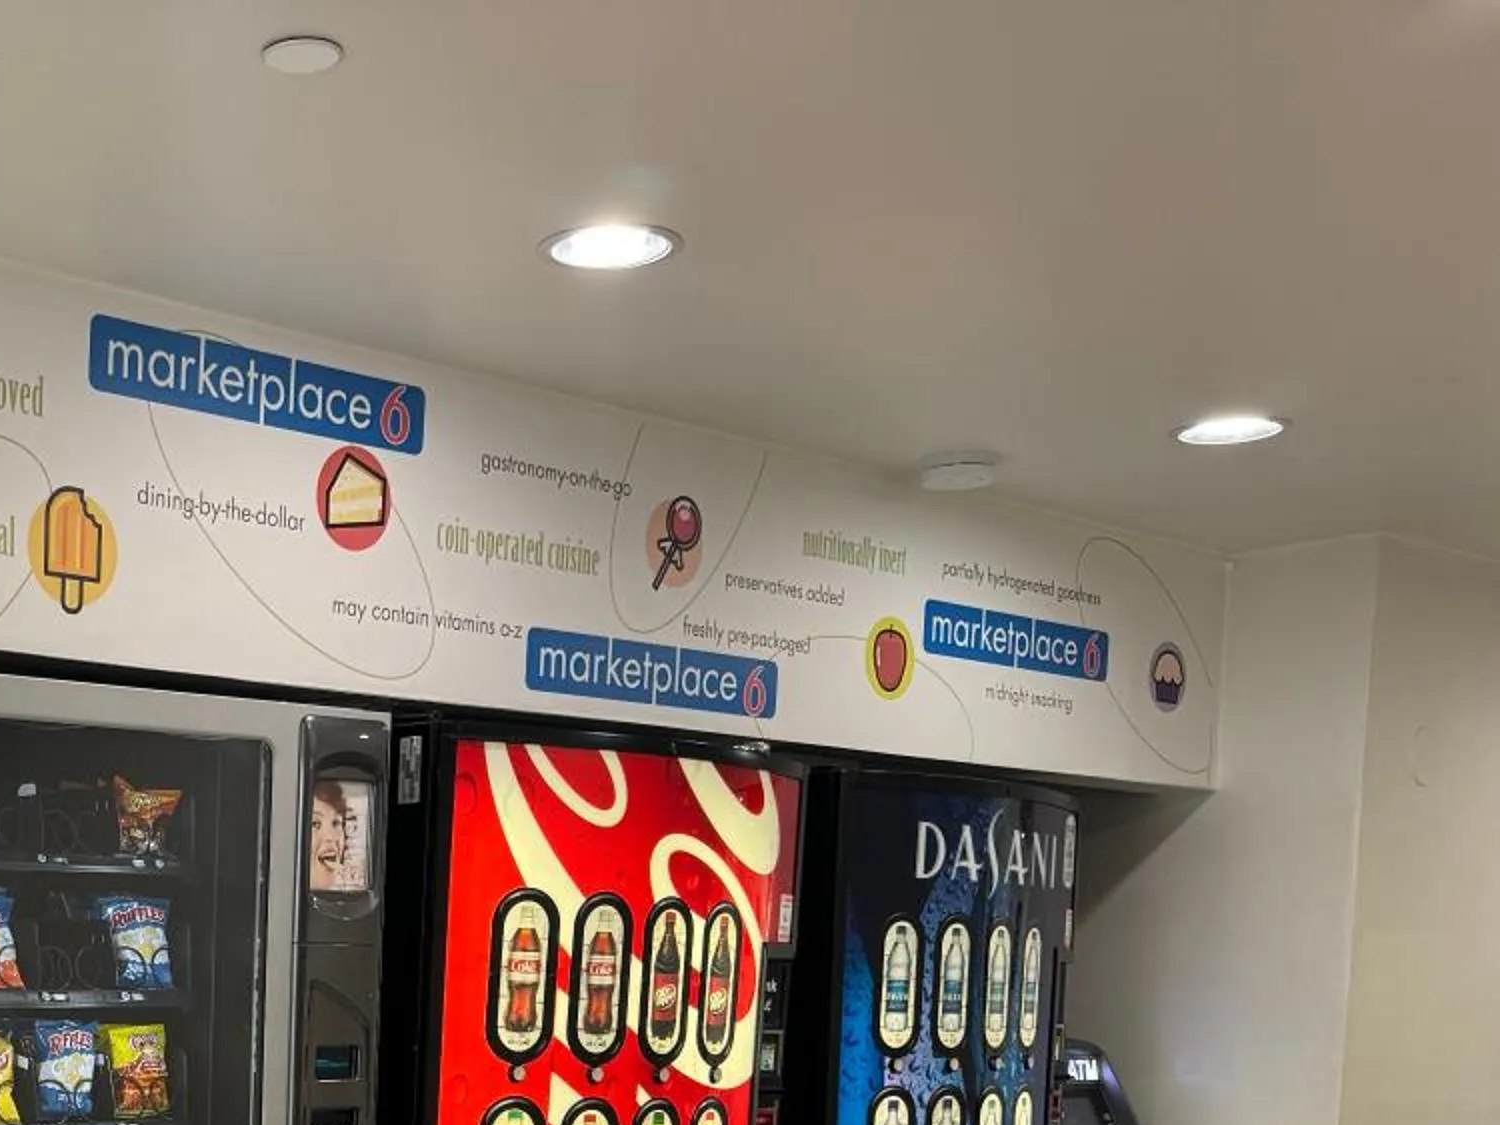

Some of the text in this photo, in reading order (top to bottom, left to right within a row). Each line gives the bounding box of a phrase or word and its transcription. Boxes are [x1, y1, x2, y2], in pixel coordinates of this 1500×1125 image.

[106, 333, 411, 447] marketplace 6
[481, 452, 632, 497] gastronomy-on-the-go
[137, 482, 305, 533] dining-by-the-dollar
[436, 518, 600, 576] coin-operated cuisine
[803, 528, 906, 576] nutritionally inert
[725, 571, 845, 607] preservatives added
[332, 599, 523, 639] may contain vitamins a-z
[683, 614, 811, 656] freshly pre-packaged
[931, 608, 1102, 678] marketplace 6
[538, 636, 766, 719] marketplace 6
[915, 808, 1057, 900] DASANI
[1067, 1059, 1099, 1081] ATM
